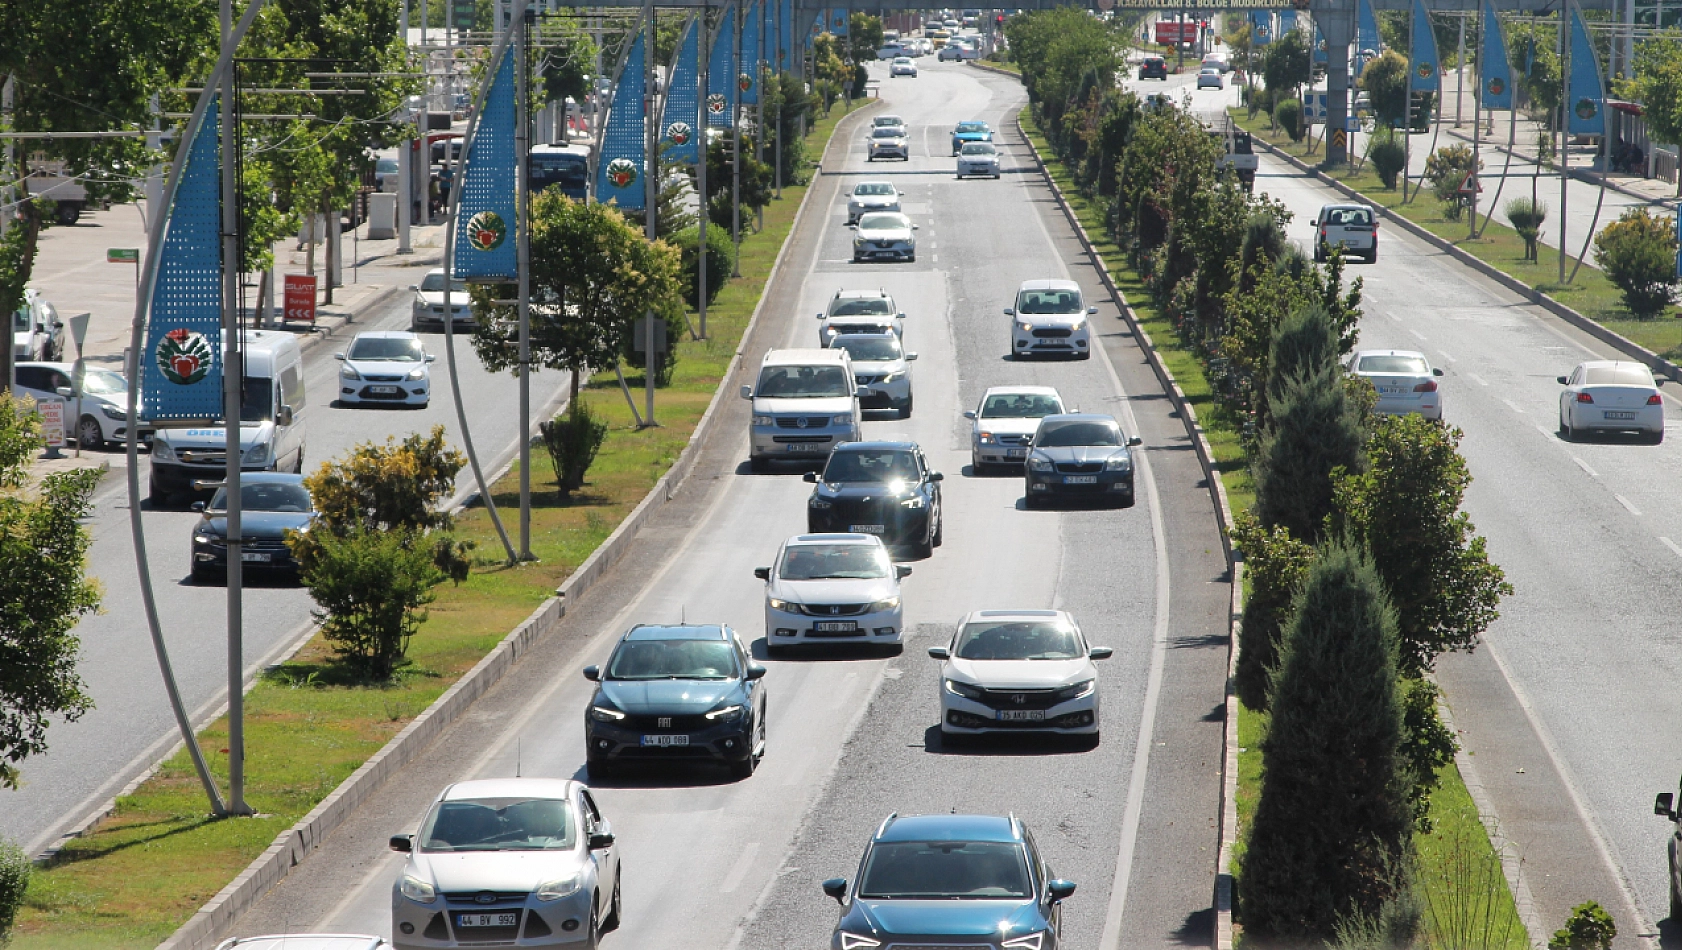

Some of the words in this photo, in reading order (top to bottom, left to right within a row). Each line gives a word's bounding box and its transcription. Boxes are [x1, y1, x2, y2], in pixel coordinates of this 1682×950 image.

[658, 717, 673, 728] FIAT
[462, 915, 473, 926] 44
[479, 915, 492, 926] BV
[498, 915, 514, 925] 992
